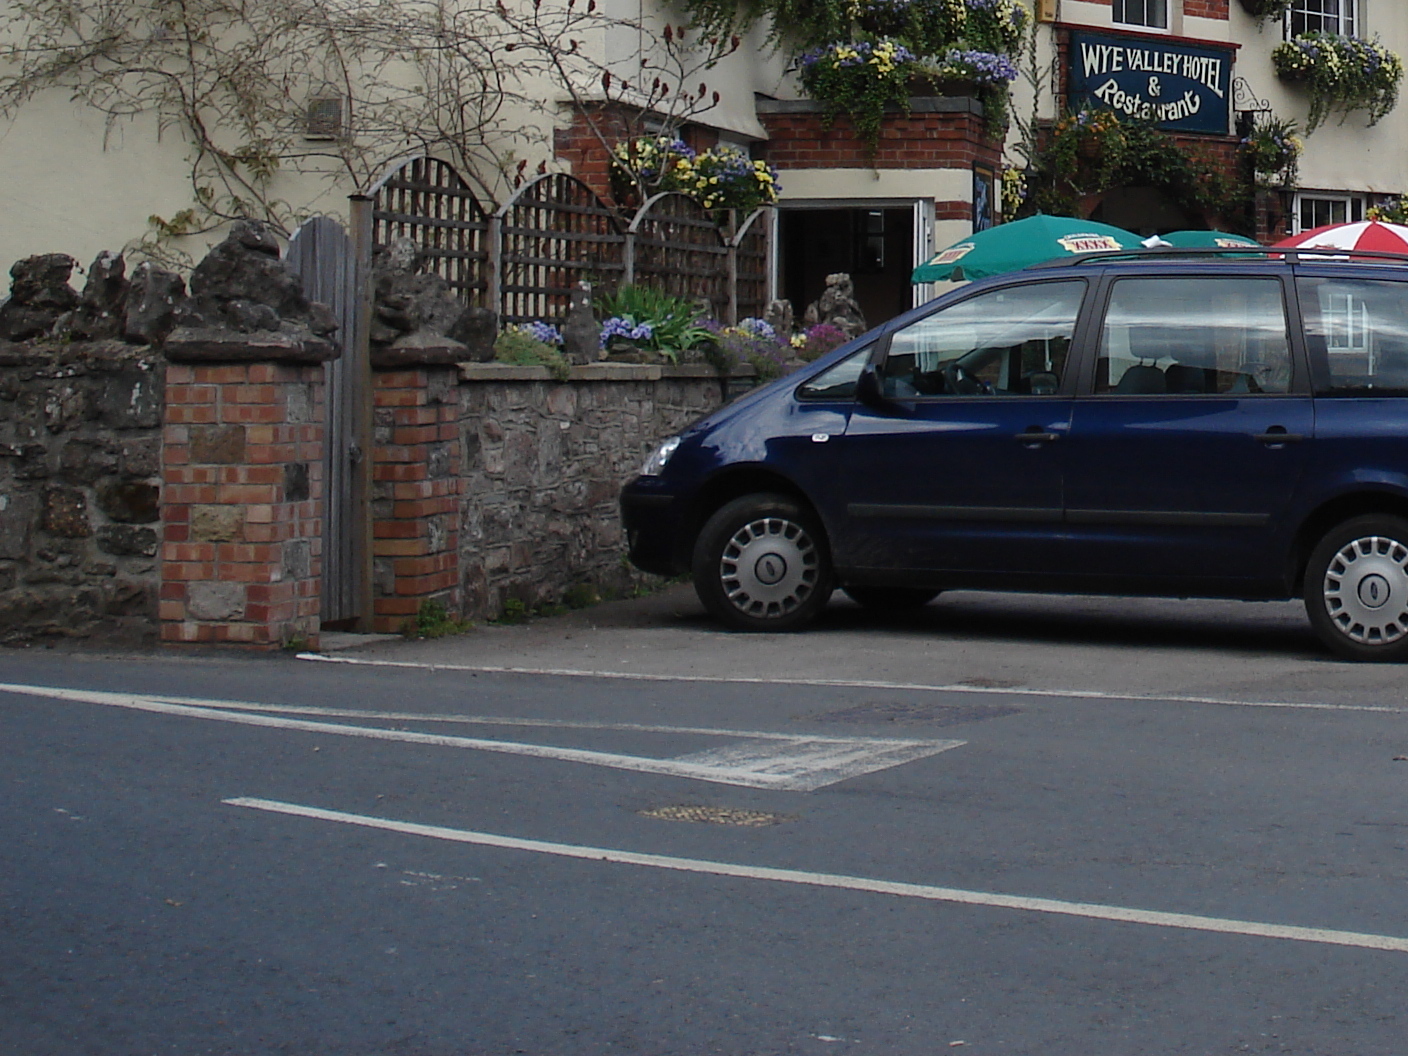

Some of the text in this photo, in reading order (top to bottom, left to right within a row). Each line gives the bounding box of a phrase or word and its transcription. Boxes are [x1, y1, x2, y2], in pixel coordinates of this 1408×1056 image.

[1081, 43, 1224, 99] WYE VALLEY HOTEL
[1148, 76, 1160, 97] &
